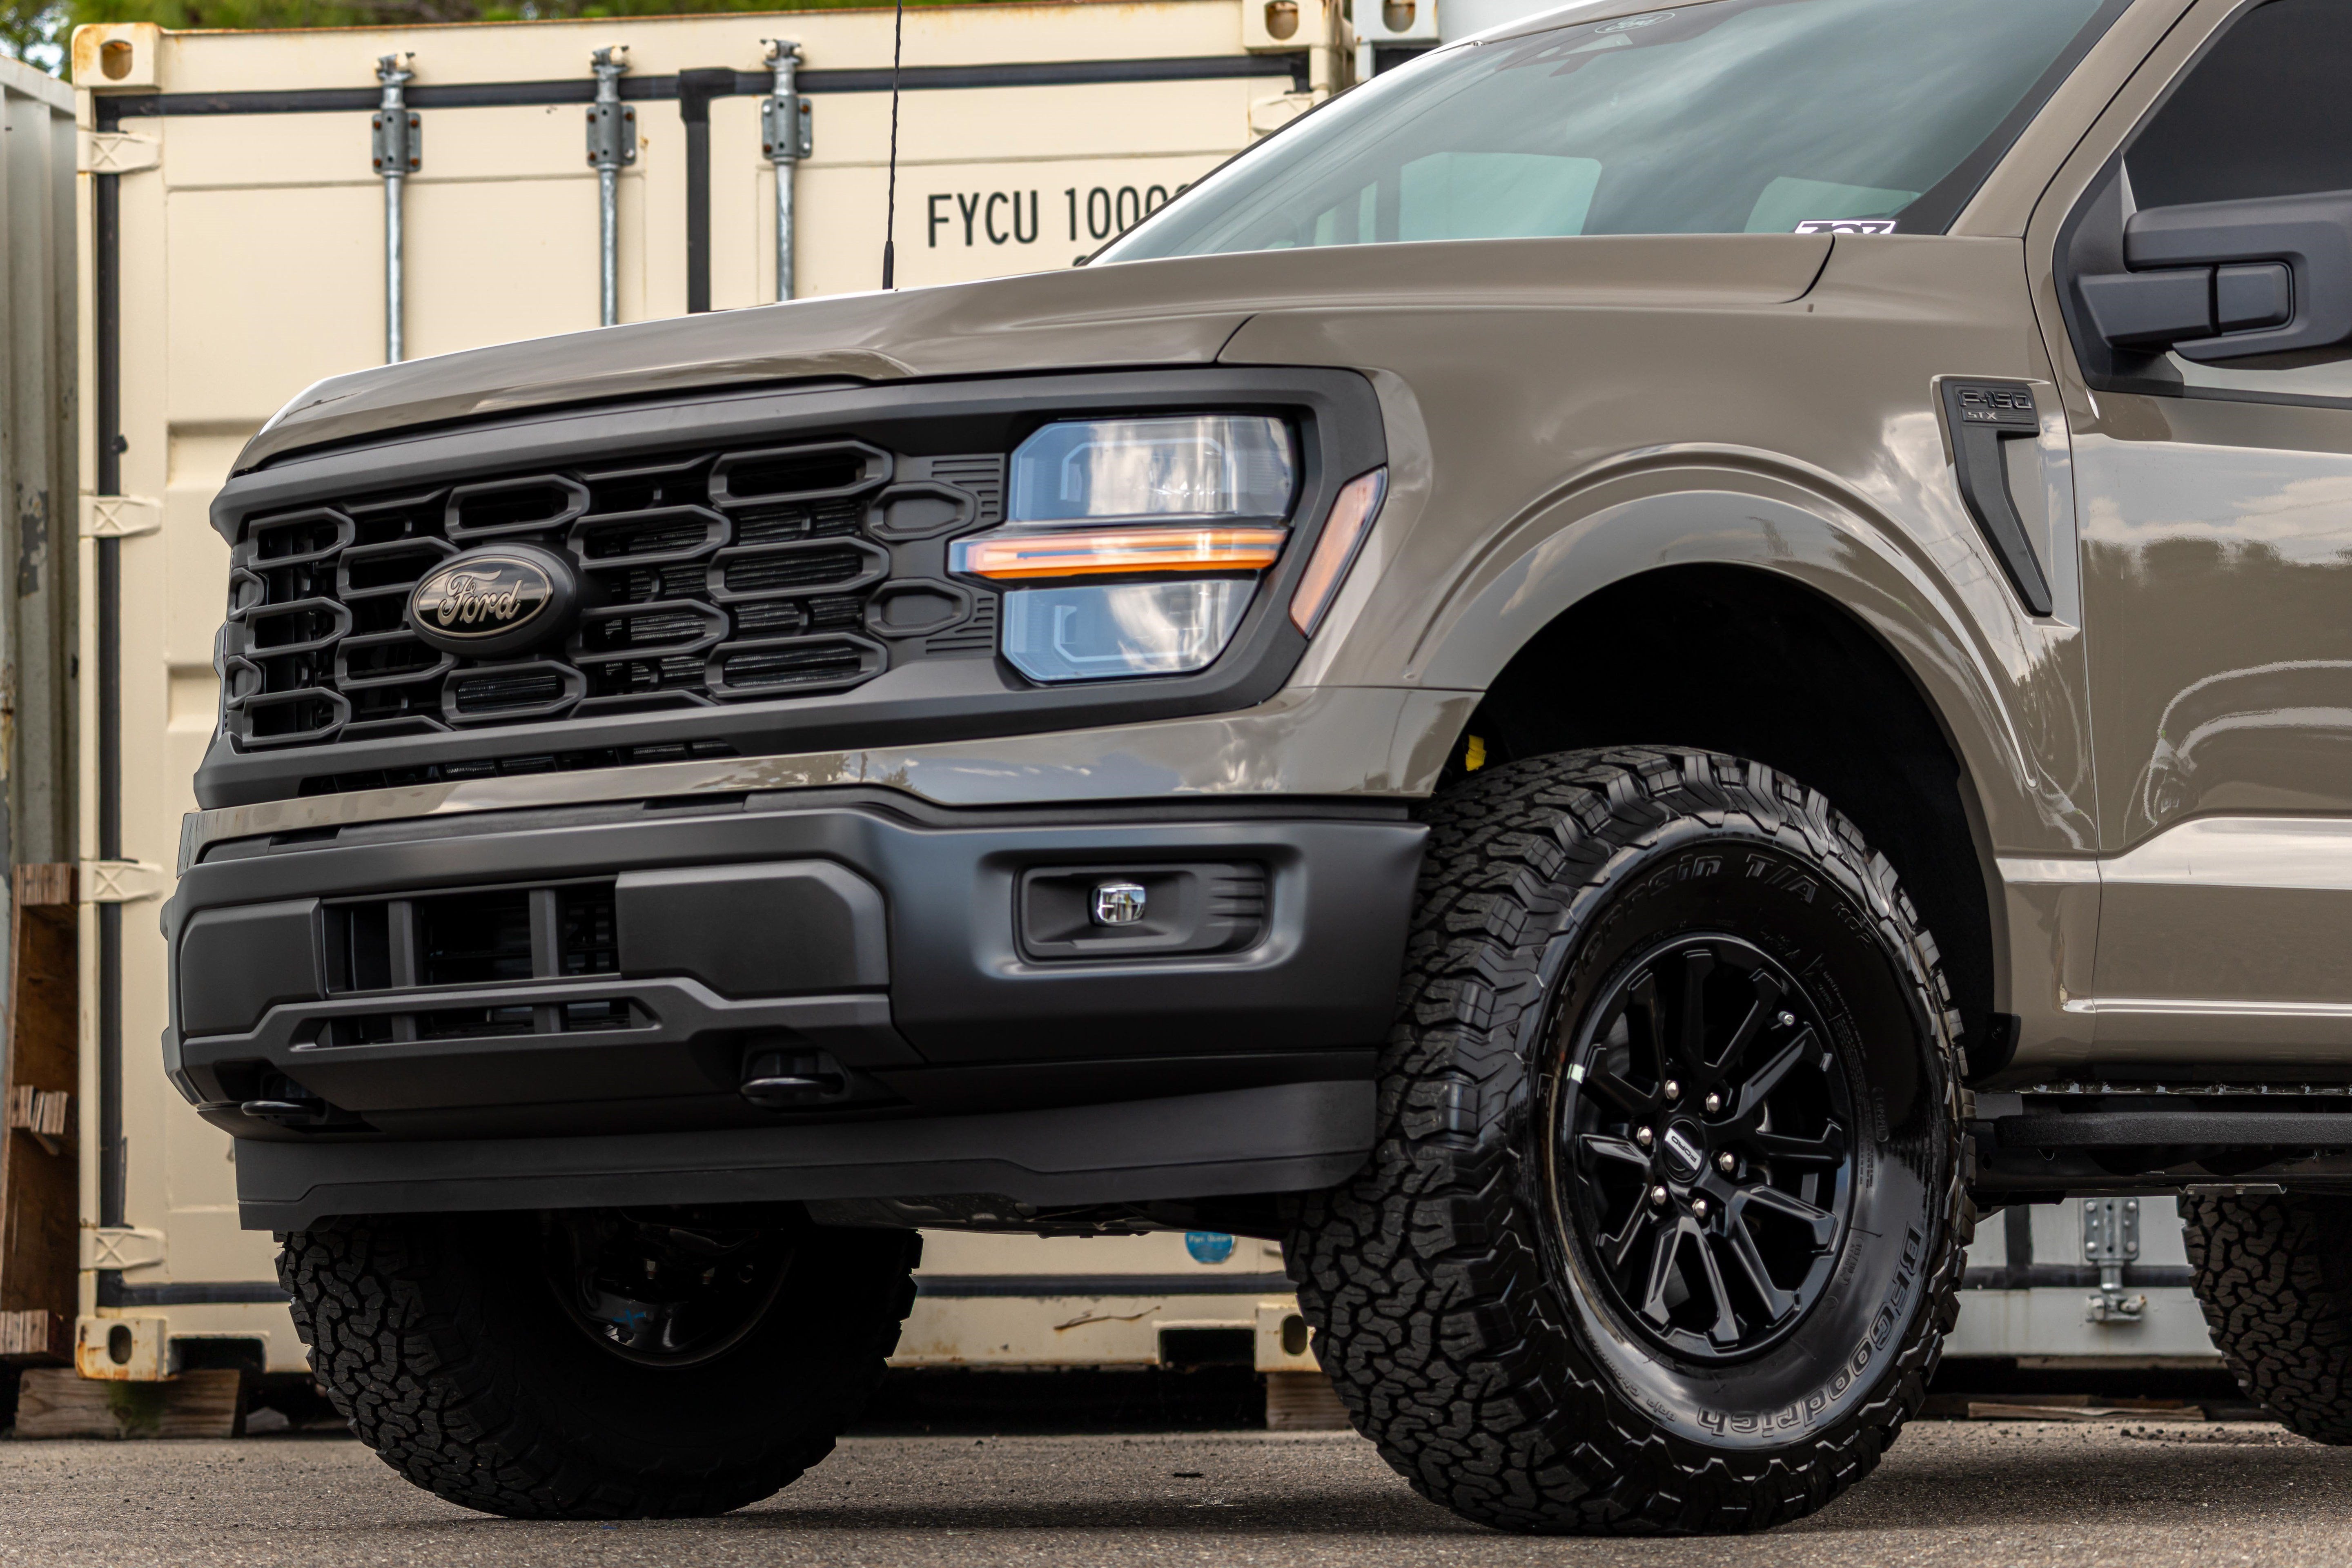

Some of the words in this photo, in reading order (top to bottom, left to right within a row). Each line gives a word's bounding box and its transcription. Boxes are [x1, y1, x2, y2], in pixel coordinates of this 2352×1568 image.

[927, 189, 1039, 248] FYCU
[1064, 183, 1189, 241] 100
[1957, 390, 2033, 409] F-150
[1967, 411, 1997, 421] STX
[437, 568, 523, 626] Ford
[1746, 853, 1820, 904] T/A
[1831, 901, 1874, 950] KO2
[1671, 1135, 1697, 1163] FORD
[1697, 1221, 1924, 1437] BFGoodrich
